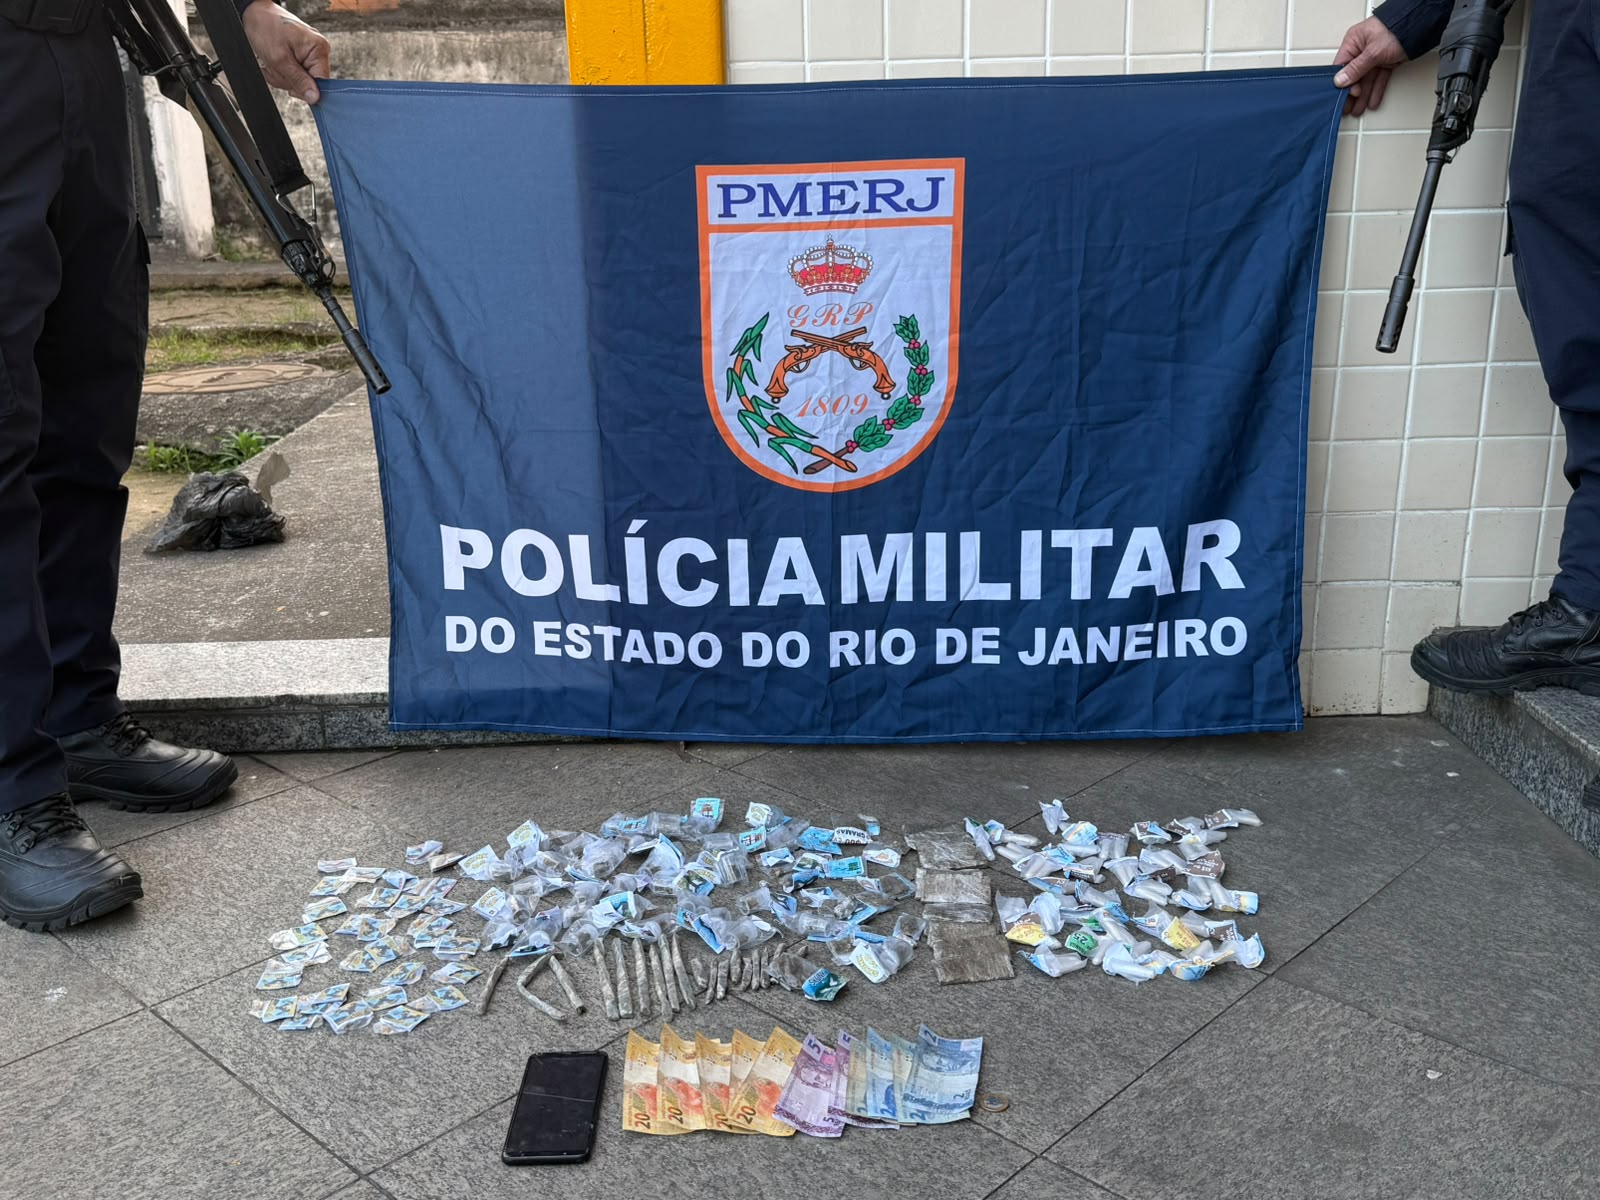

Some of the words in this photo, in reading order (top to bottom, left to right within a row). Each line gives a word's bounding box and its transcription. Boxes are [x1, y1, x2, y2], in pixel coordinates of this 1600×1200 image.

[717, 177, 945, 218] PMERJ
[795, 393, 869, 418] 1809
[440, 519, 826, 608] POLÍCIA
[840, 518, 1246, 605] MILITAR
[445, 615, 516, 654] DO
[533, 620, 723, 669] ESTADO
[741, 630, 811, 669] DO
[829, 628, 916, 668] RIO
[935, 627, 1000, 665] DE
[1018, 616, 1248, 666] JANEIRO
[1073, 932, 1088, 945] 25
[807, 1039, 822, 1055] 5
[924, 1029, 937, 1046] 2
[634, 1112, 651, 1129] 20
[668, 1106, 684, 1125] 20
[737, 1105, 756, 1124] 20
